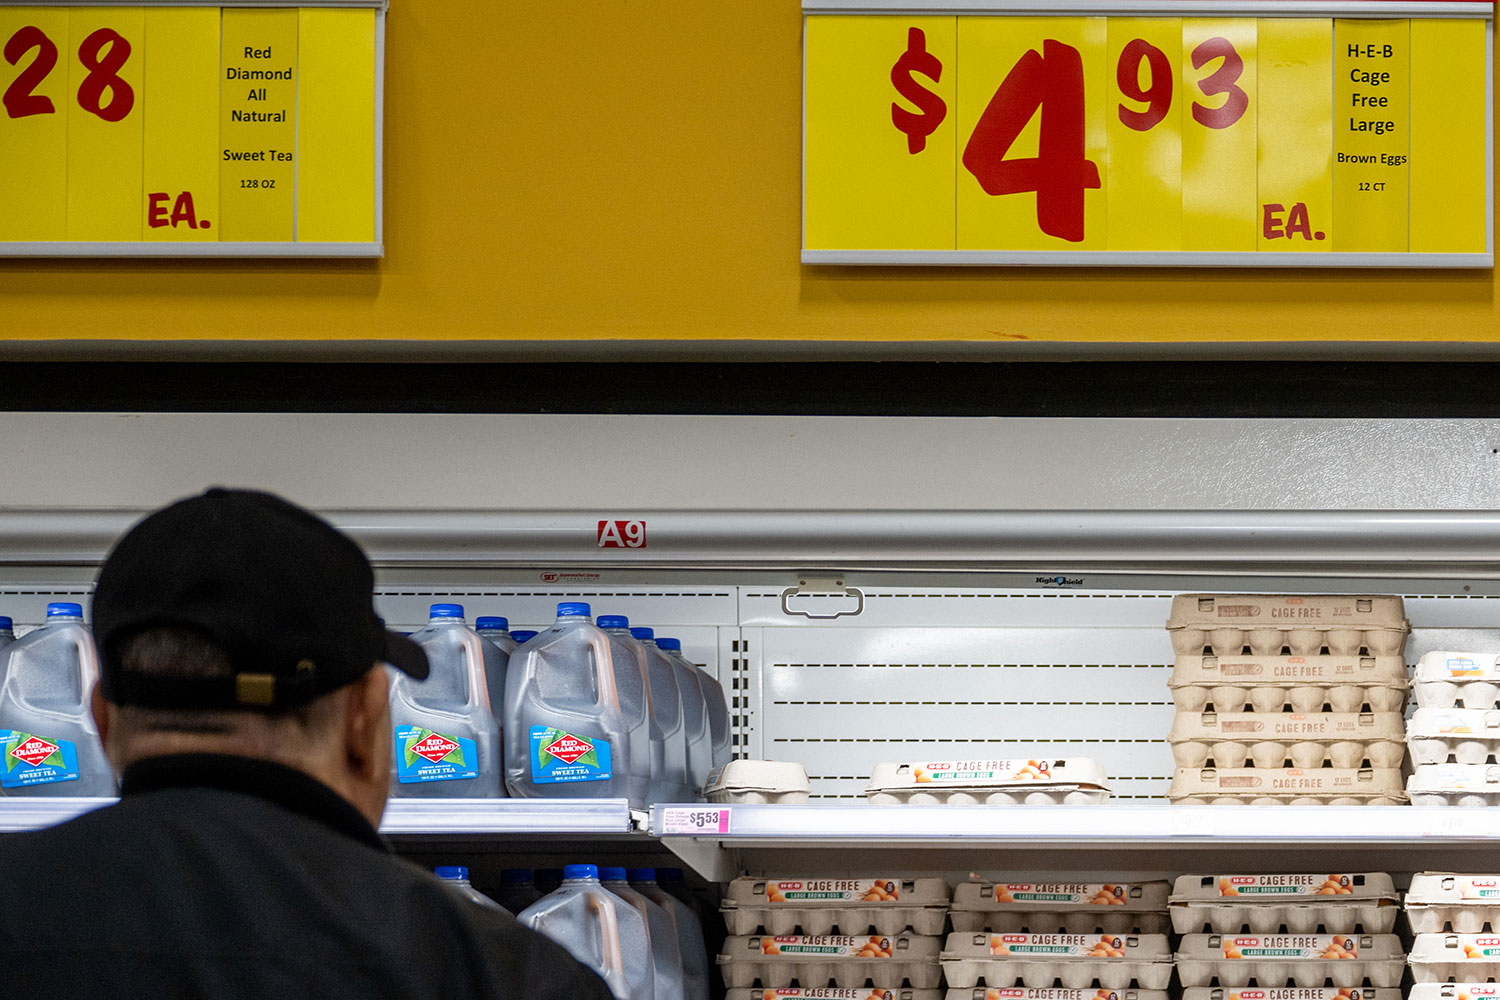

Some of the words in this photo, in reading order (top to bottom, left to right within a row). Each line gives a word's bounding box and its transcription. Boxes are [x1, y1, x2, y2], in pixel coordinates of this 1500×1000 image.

[244, 46, 272, 59] Red
[1347, 45, 1393, 58] H-E-B
[226, 67, 292, 80] Diamond
[1350, 68, 1390, 86] Cage
[247, 89, 267, 101] All
[1352, 94, 1388, 108] Free
[231, 110, 286, 123] Natural
[1350, 118, 1395, 134] Large
[223, 149, 265, 162] Sweet
[269, 149, 293, 162] Tea
[1337, 152, 1377, 164] Brown
[1380, 152, 1407, 167] Eggs
[240, 179, 259, 189] 128
[261, 179, 276, 189] OZ
[1358, 182, 1370, 192] 12
[1372, 182, 1386, 192] CT
[148, 191, 211, 229] EA.
[1263, 202, 1326, 241] EA.
[598, 520, 647, 548] A9
[1272, 608, 1295, 618] CAGE
[1298, 608, 1321, 618] FREE
[1274, 667, 1297, 677] CAGE
[1300, 667, 1323, 677] FREE
[26, 742, 43, 750] RED
[416, 744, 455, 752] DIAMOND
[550, 744, 589, 753] DIAMOND
[561, 739, 577, 747] RED
[16, 746, 55, 756] DIAMOND
[19, 771, 41, 780] SWEET
[807, 881, 832, 891] CAGE
[835, 881, 859, 891] FREE
